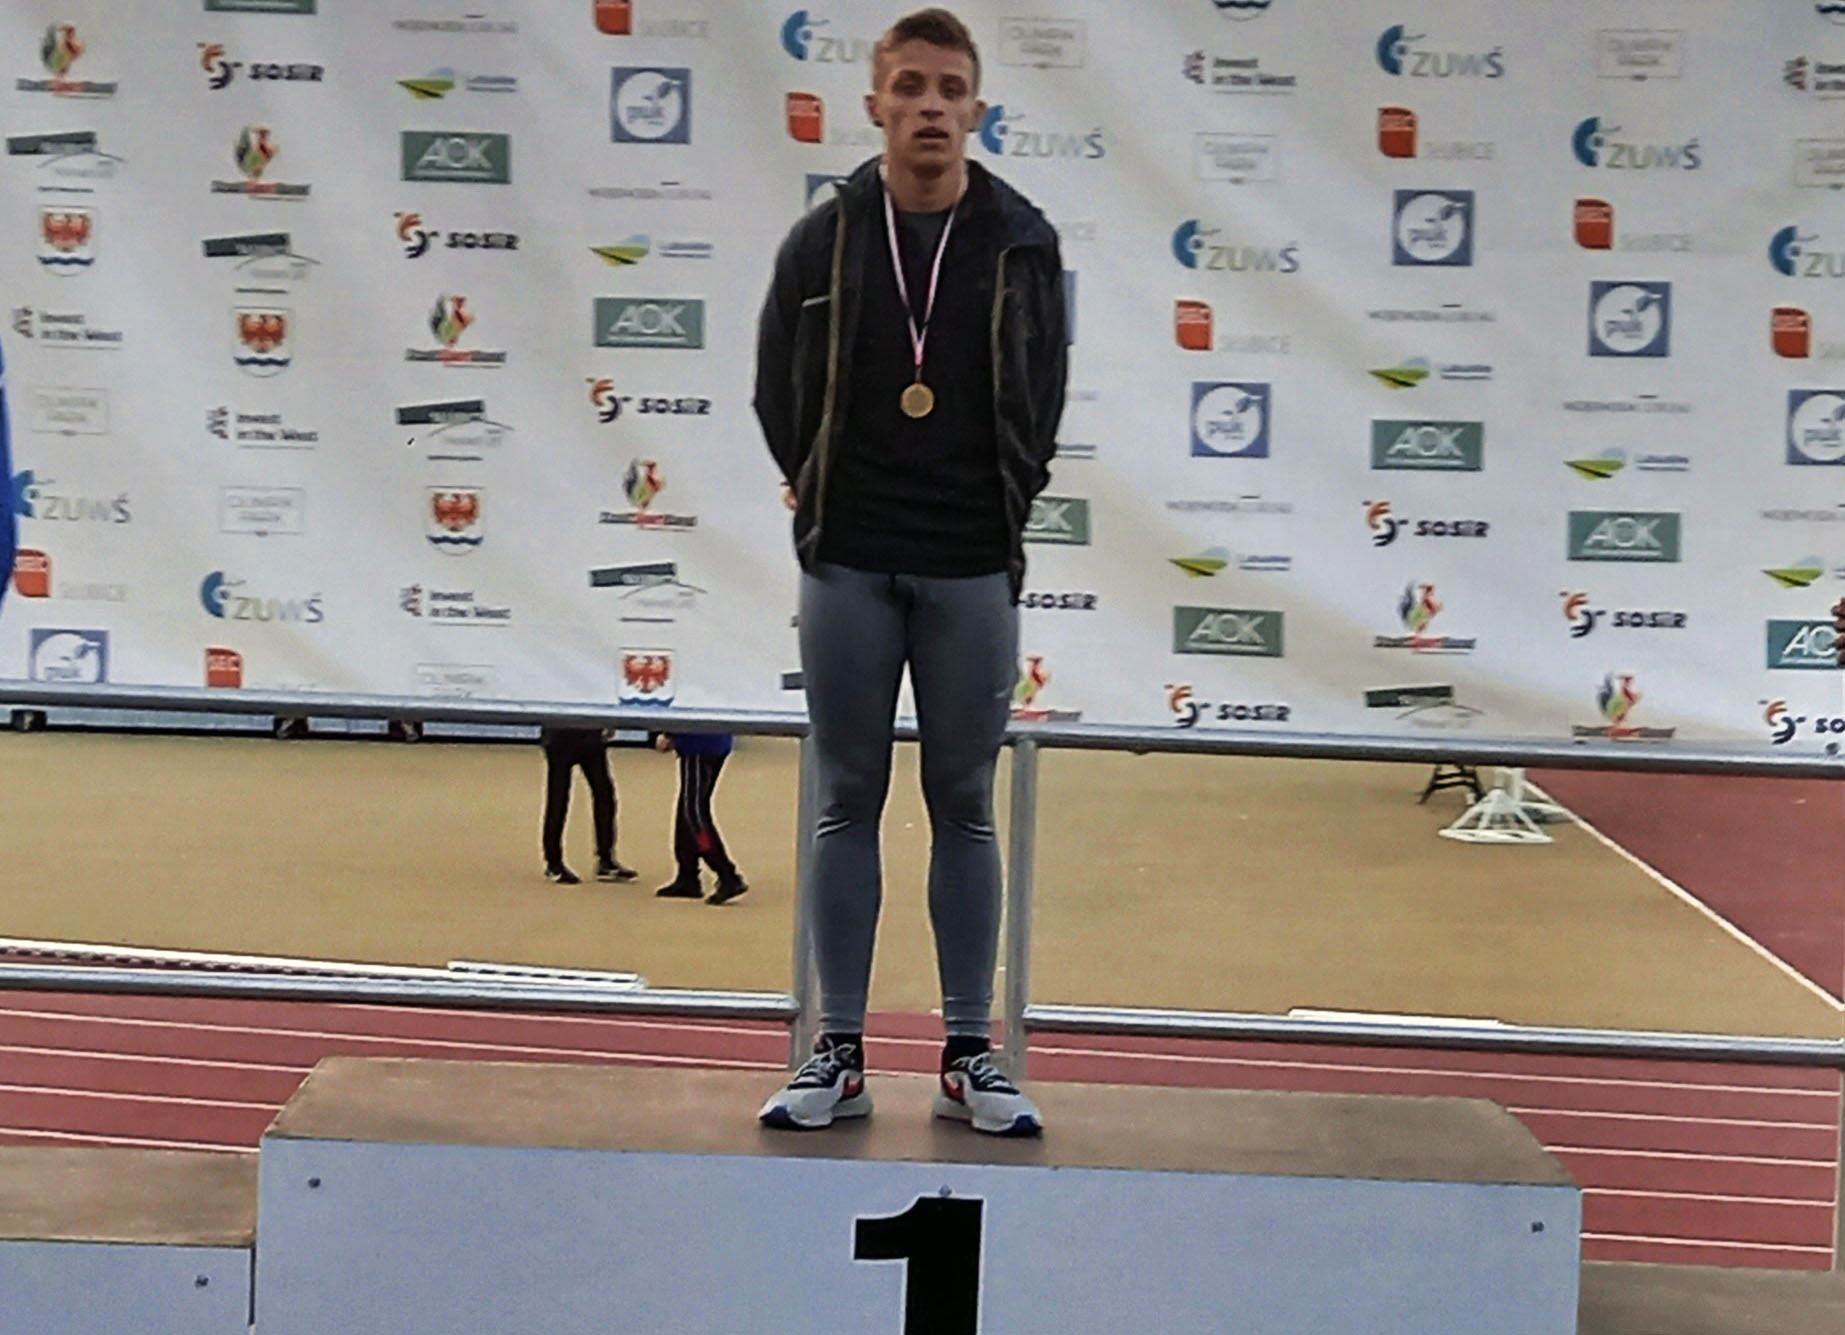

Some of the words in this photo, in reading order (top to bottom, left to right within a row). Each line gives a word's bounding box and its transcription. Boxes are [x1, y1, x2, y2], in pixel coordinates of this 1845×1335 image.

[815, 37, 876, 62] ZUW
[416, 137, 493, 169] AOK
[1803, 252, 1845, 278] ZU
[609, 303, 687, 334] AOK
[1386, 426, 1465, 457] AOK
[1024, 499, 1072, 530] OK
[1583, 516, 1662, 547] AOK
[1188, 612, 1265, 644] AOK
[1782, 625, 1838, 657] AO
[853, 1196, 985, 1335] 1
